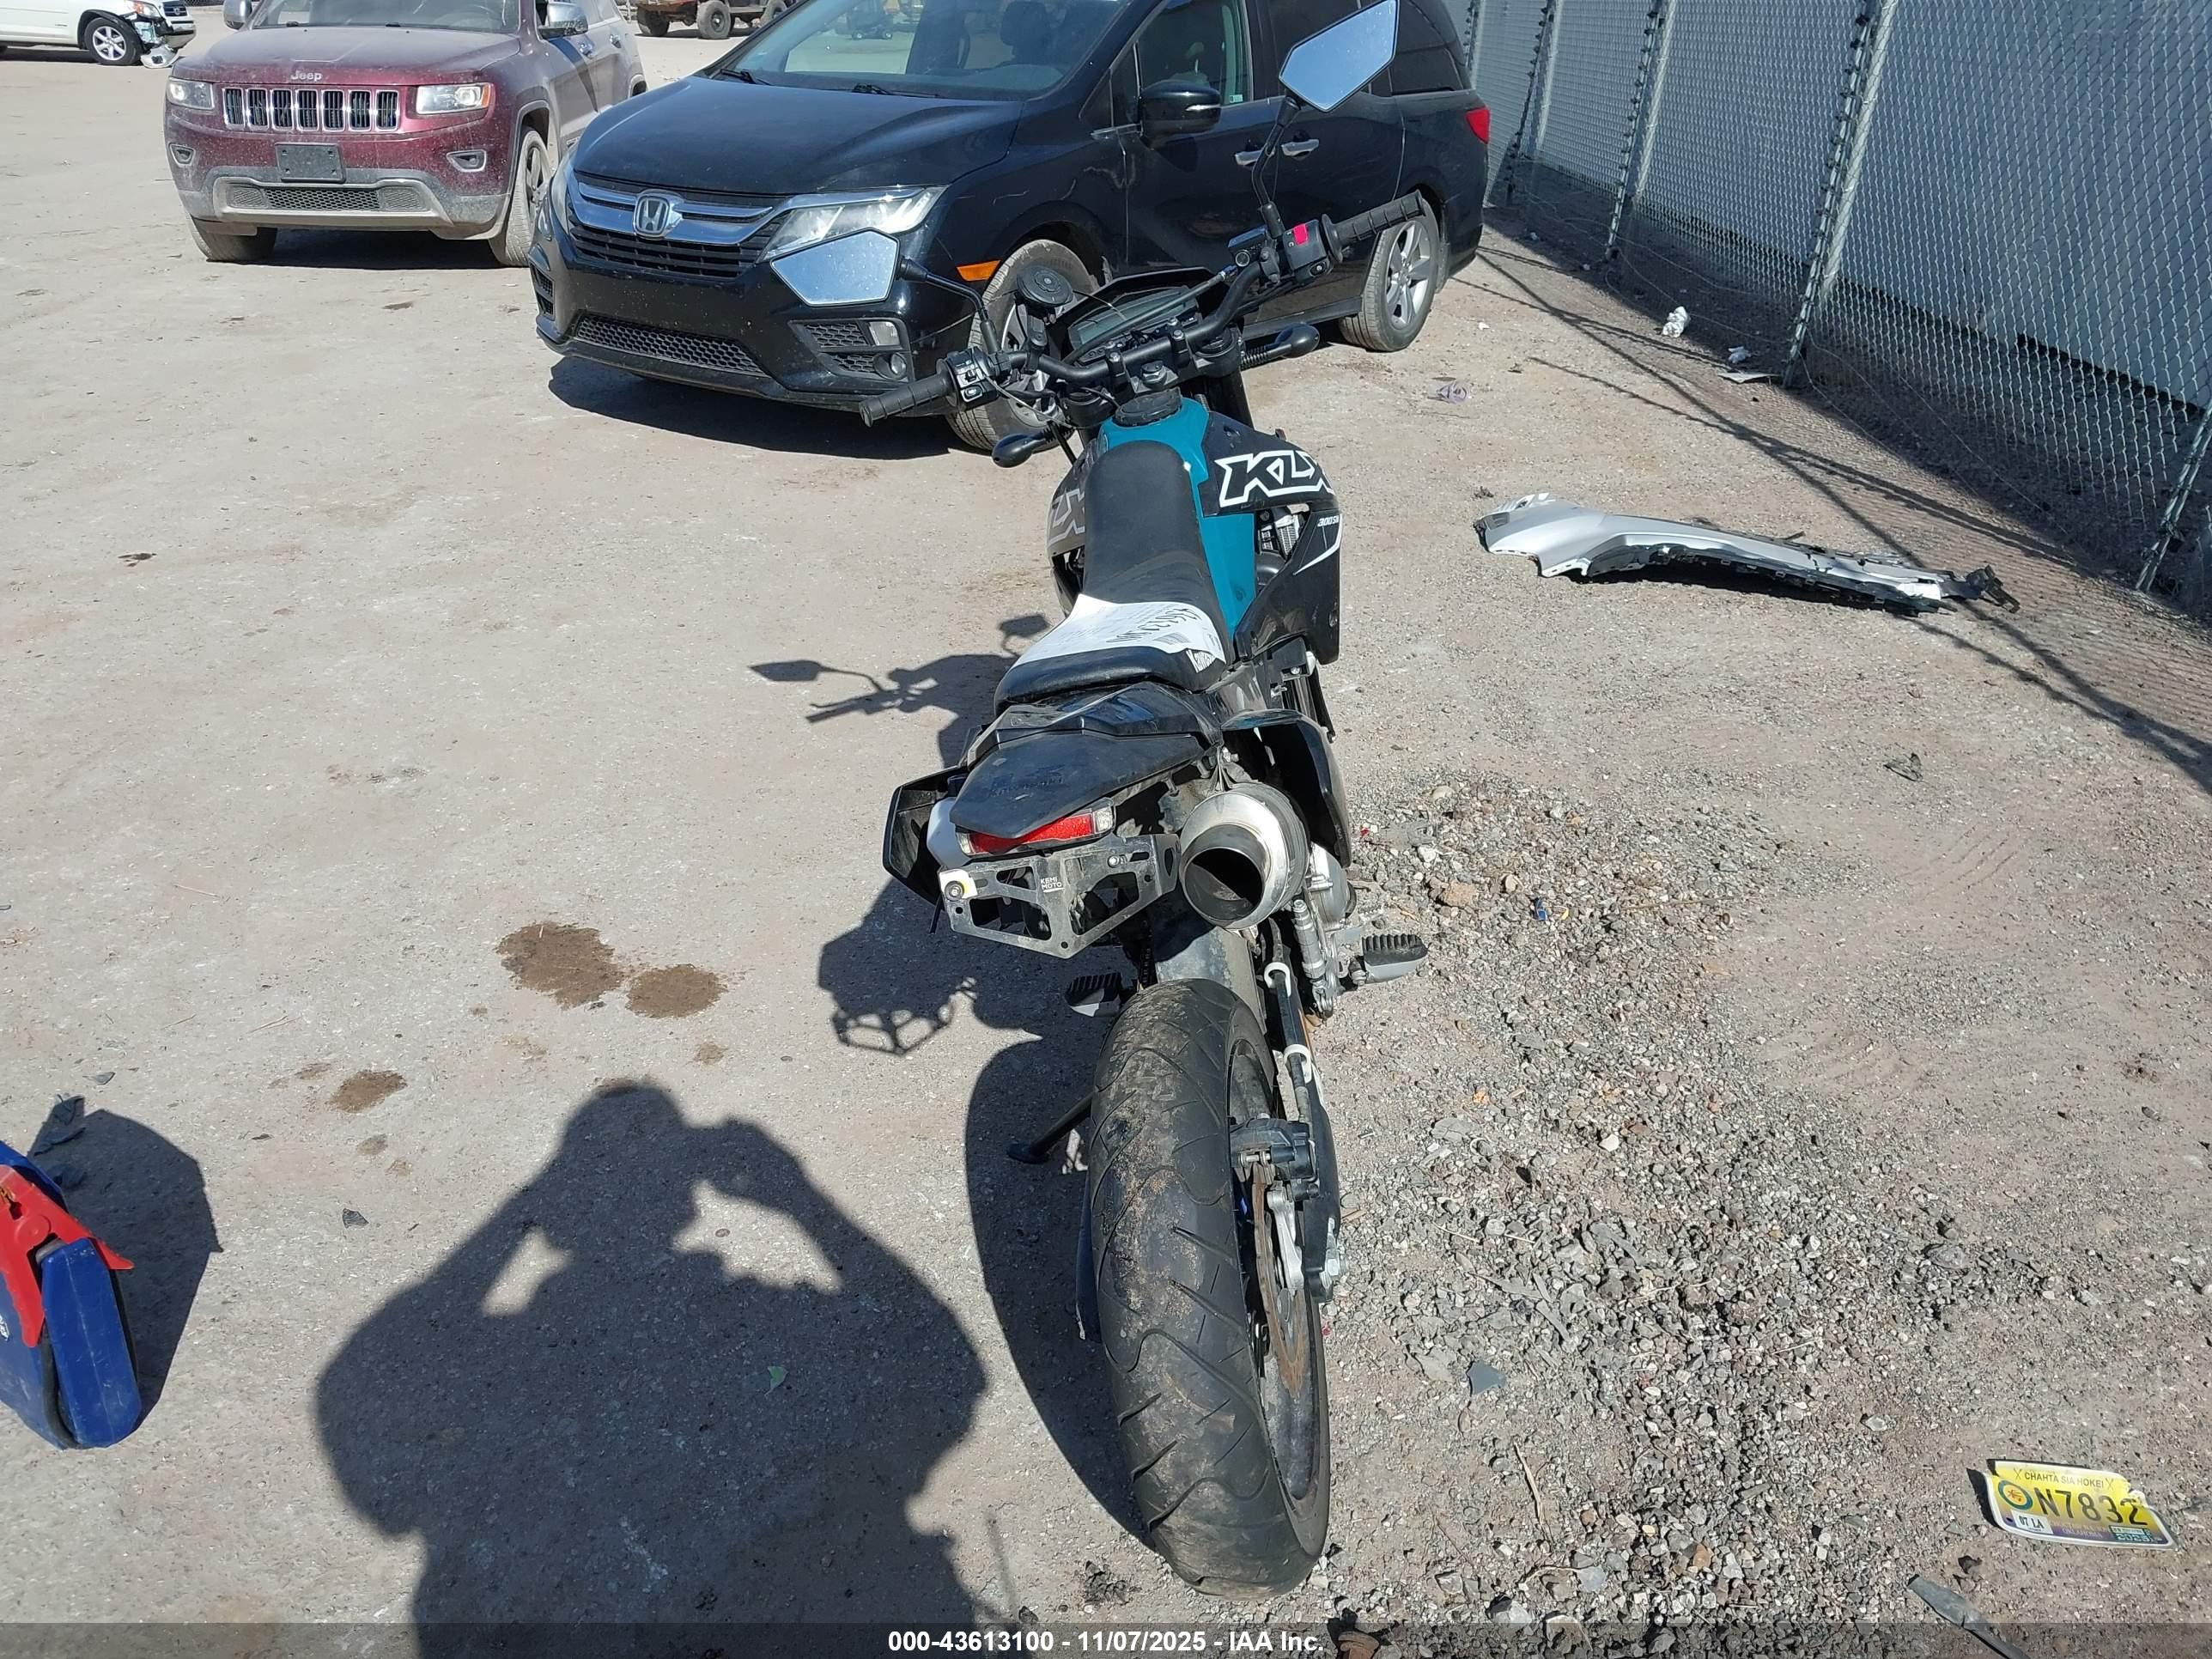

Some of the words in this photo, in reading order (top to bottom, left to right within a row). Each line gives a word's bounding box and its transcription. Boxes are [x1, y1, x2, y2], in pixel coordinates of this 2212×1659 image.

[290, 70, 323, 82] Jeep
[1214, 450, 1334, 507] KLX
[1041, 882, 1062, 890] MOTO
[2024, 1472, 2059, 1483] CHAHTA
[2061, 1475, 2075, 1485] SIA
[2033, 1486, 2148, 1525] N7832
